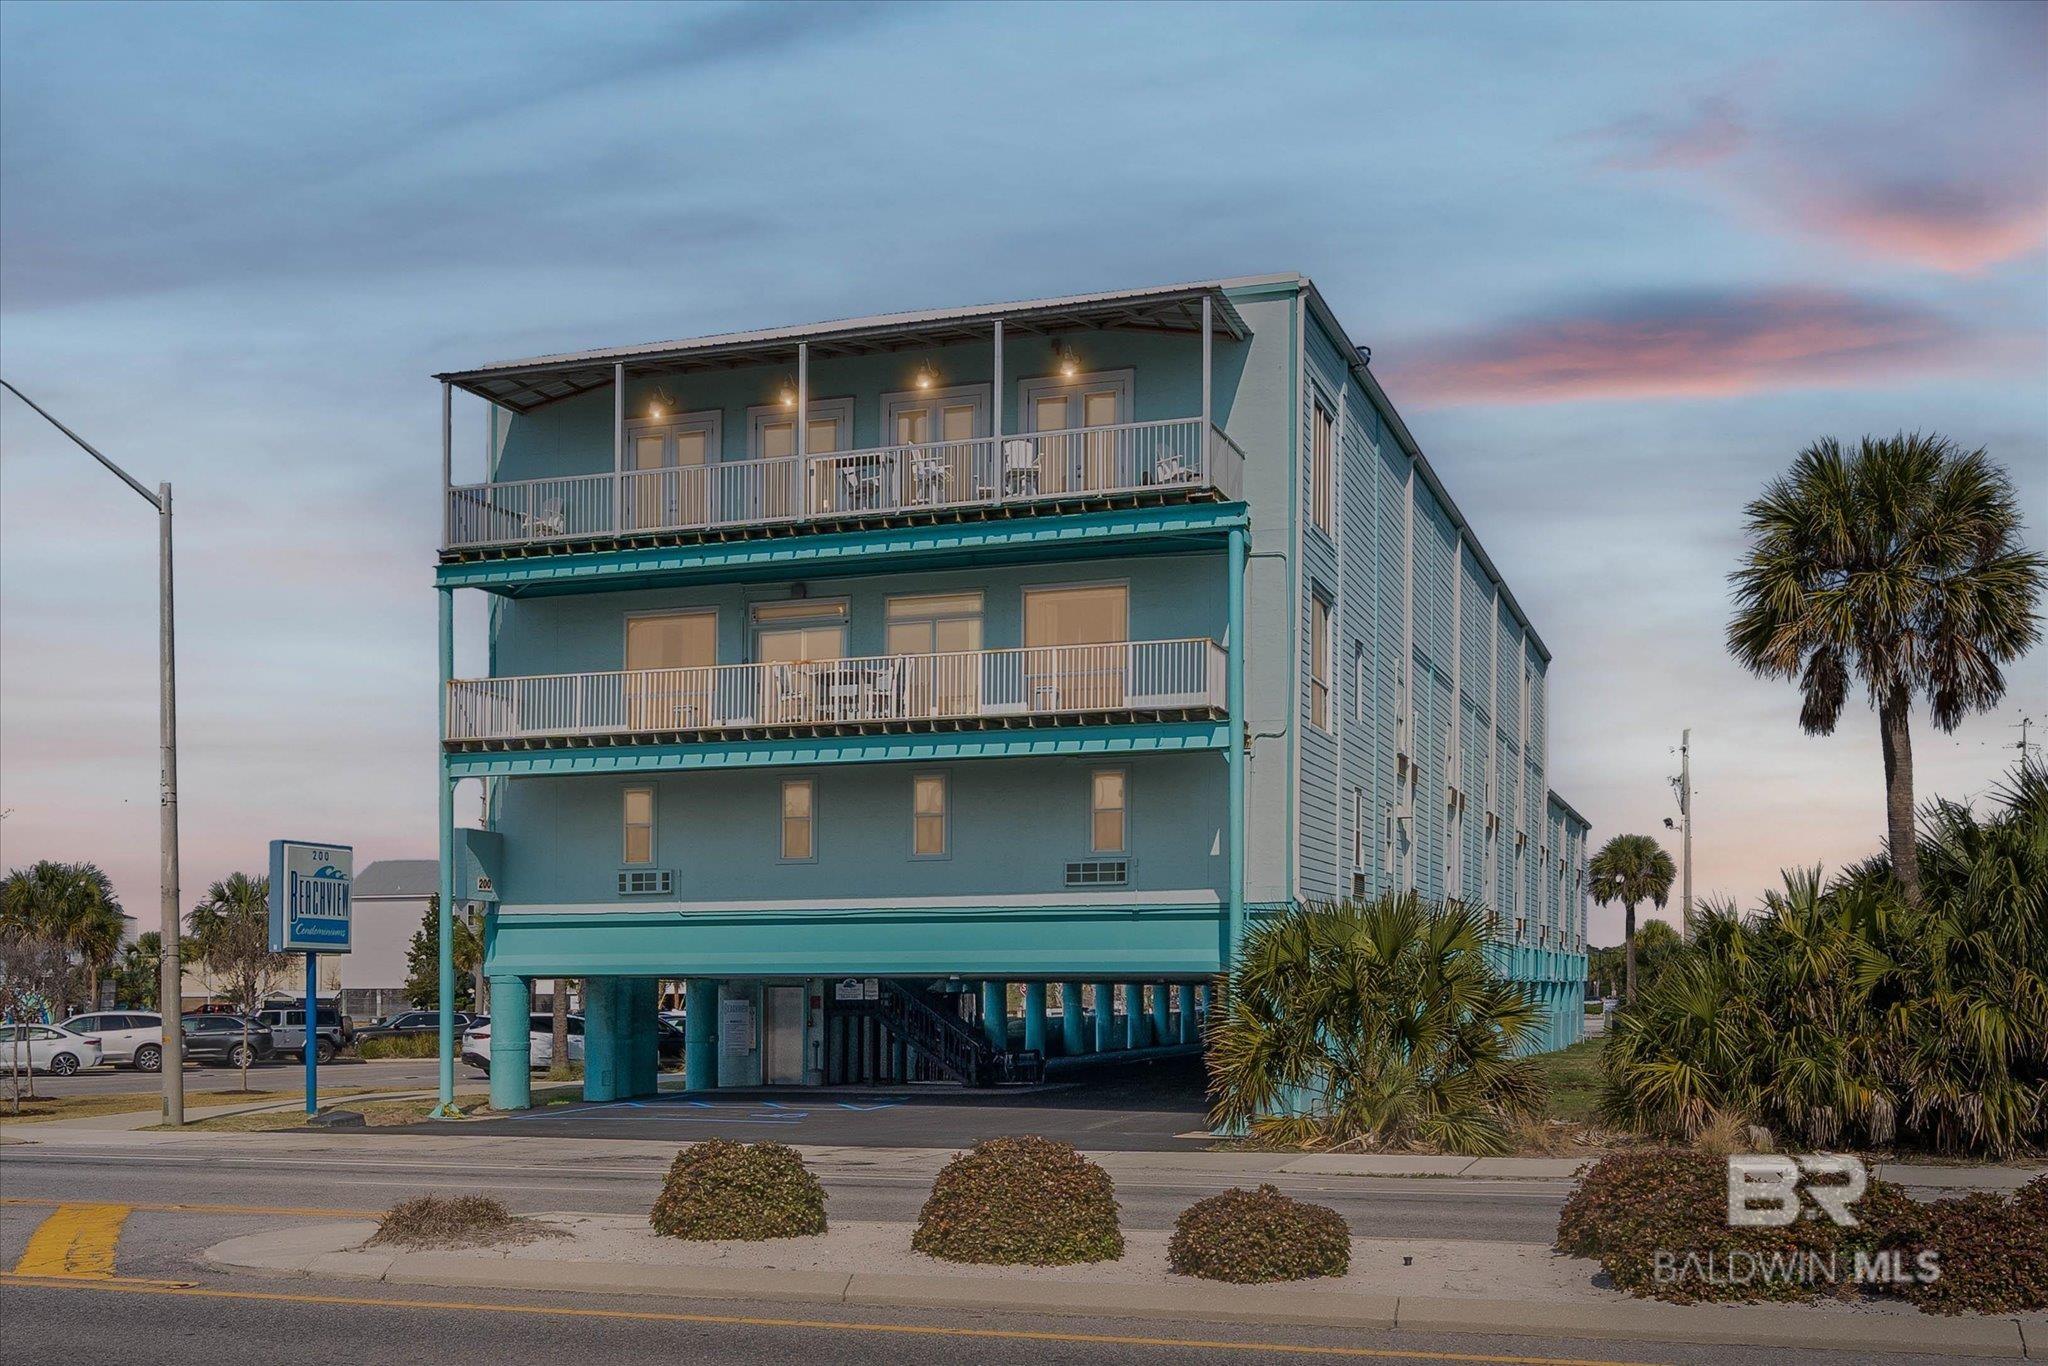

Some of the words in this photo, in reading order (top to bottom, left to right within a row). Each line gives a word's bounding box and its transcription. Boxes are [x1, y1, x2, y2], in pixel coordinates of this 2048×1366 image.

[312, 850, 330, 861] 200
[478, 879, 491, 889] 200
[291, 871, 350, 922] BEACHVIEW
[296, 923, 346, 937] Condominiums
